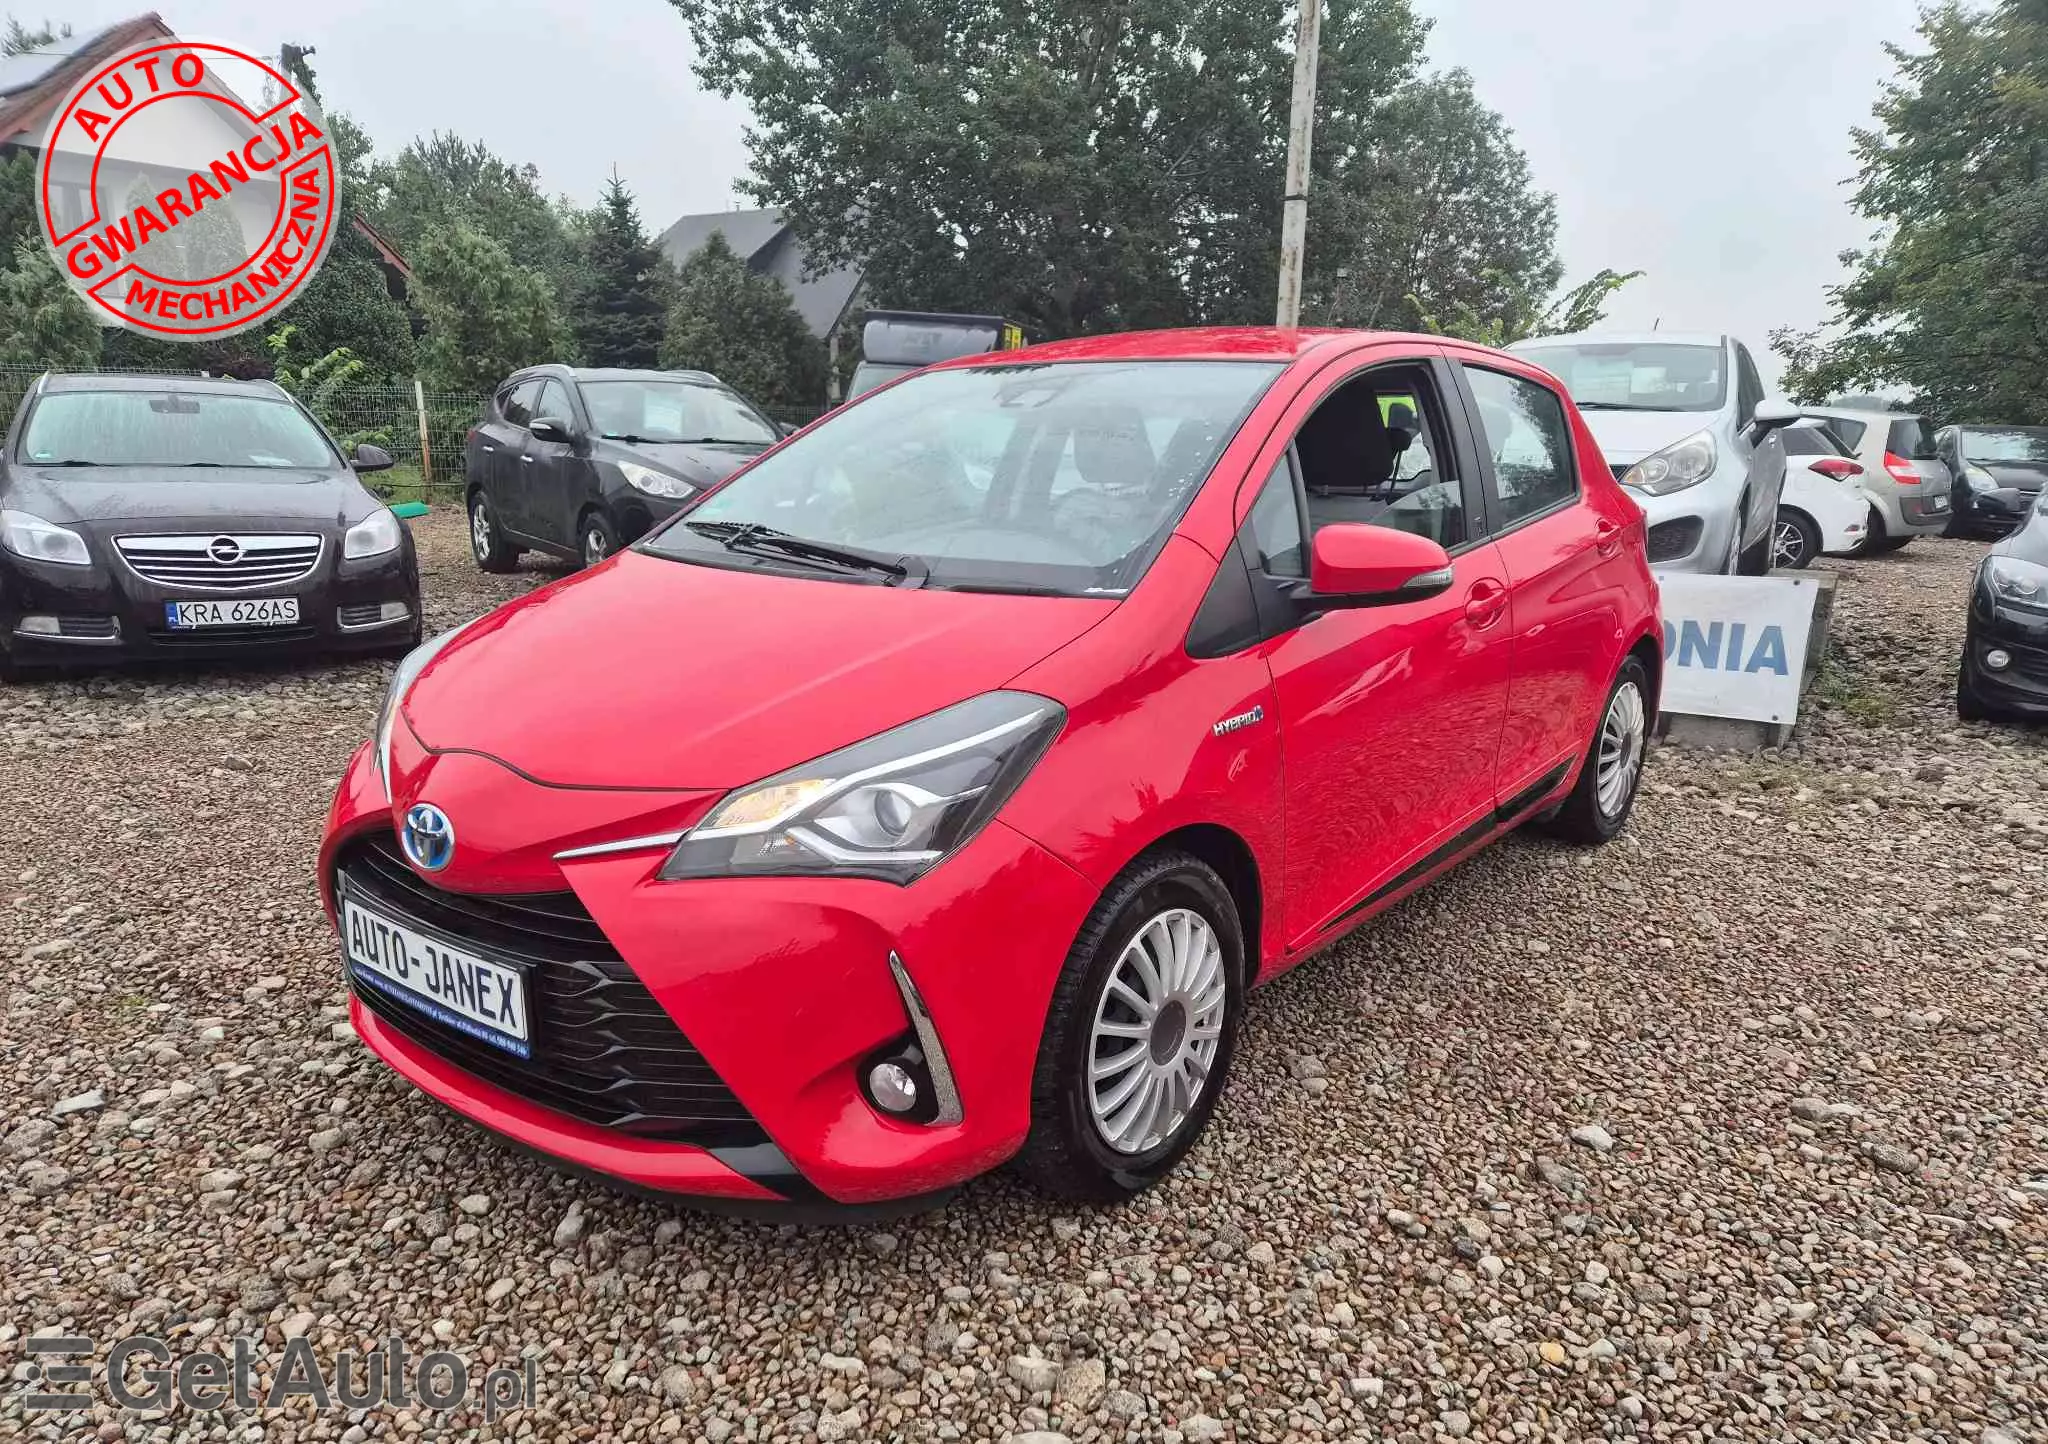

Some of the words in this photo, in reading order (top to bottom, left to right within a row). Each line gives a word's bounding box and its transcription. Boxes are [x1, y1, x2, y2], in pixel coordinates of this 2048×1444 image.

[179, 603, 223, 623] KRA
[231, 601, 297, 621] 626AS
[1664, 619, 1789, 676] NIA
[352, 910, 517, 1029] AUTO-JANEX
